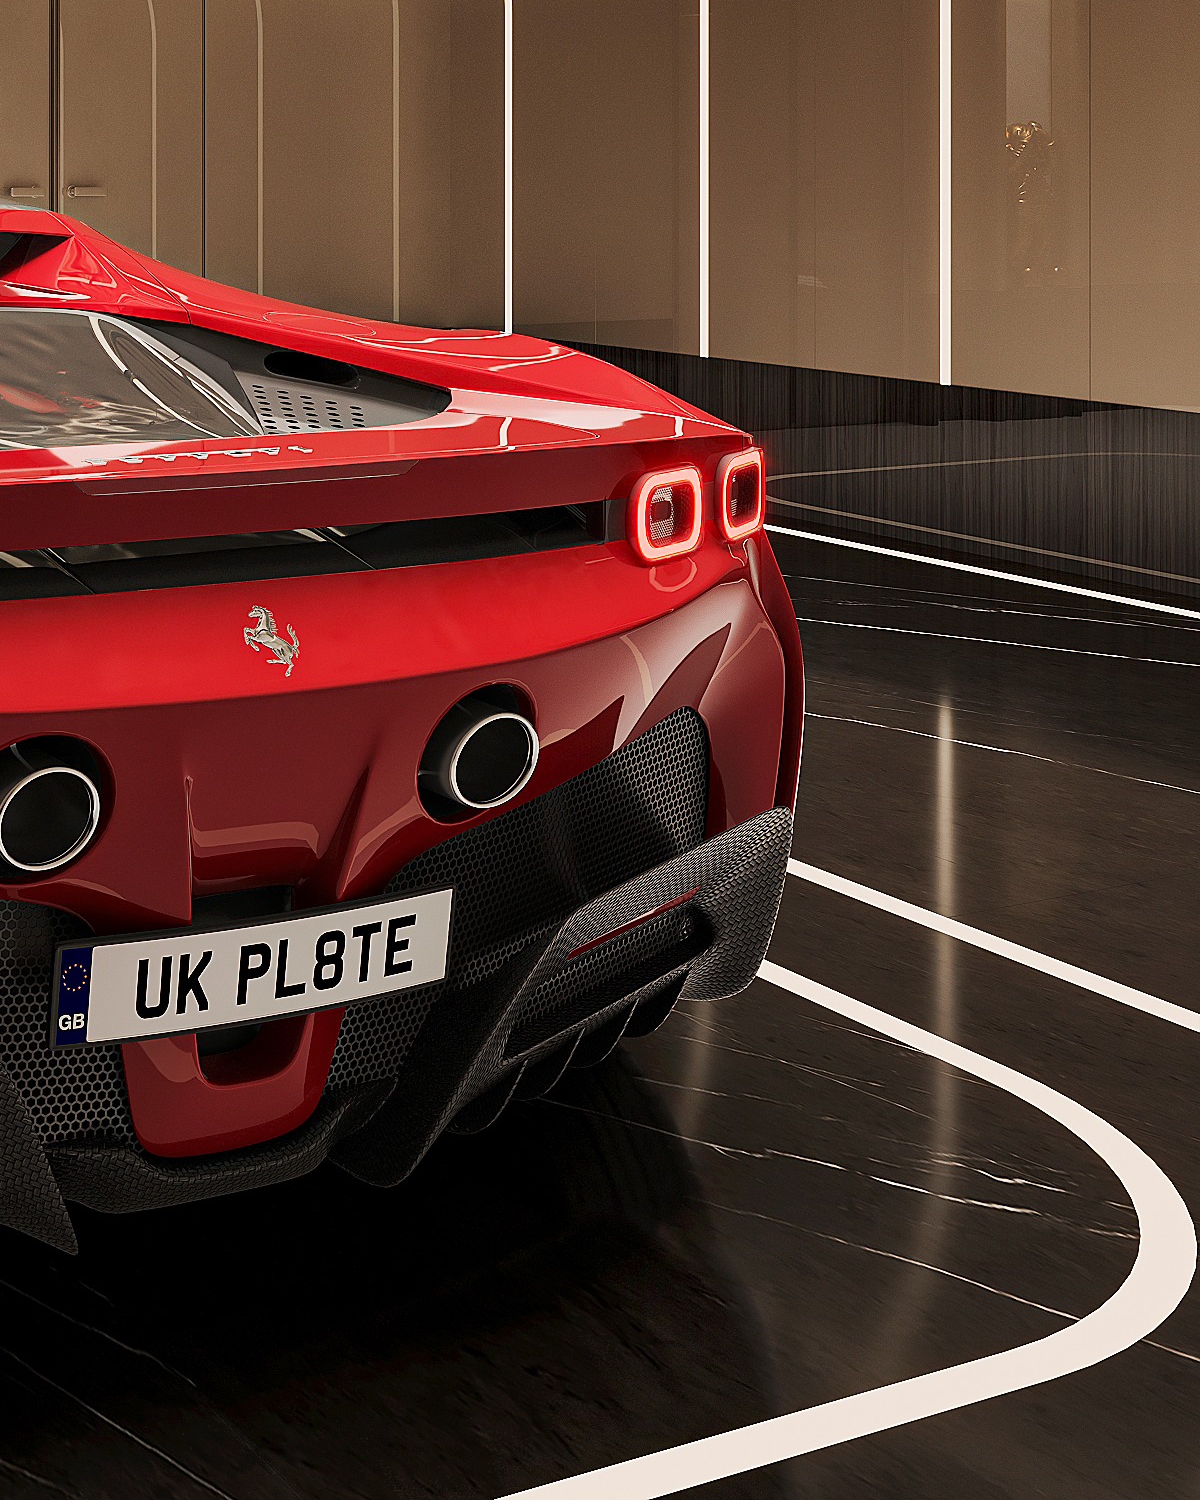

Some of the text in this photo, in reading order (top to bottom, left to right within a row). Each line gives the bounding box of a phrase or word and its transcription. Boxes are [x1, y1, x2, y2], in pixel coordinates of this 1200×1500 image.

[134, 913, 417, 1020] UK PL8TE
[58, 1013, 85, 1031] GB
